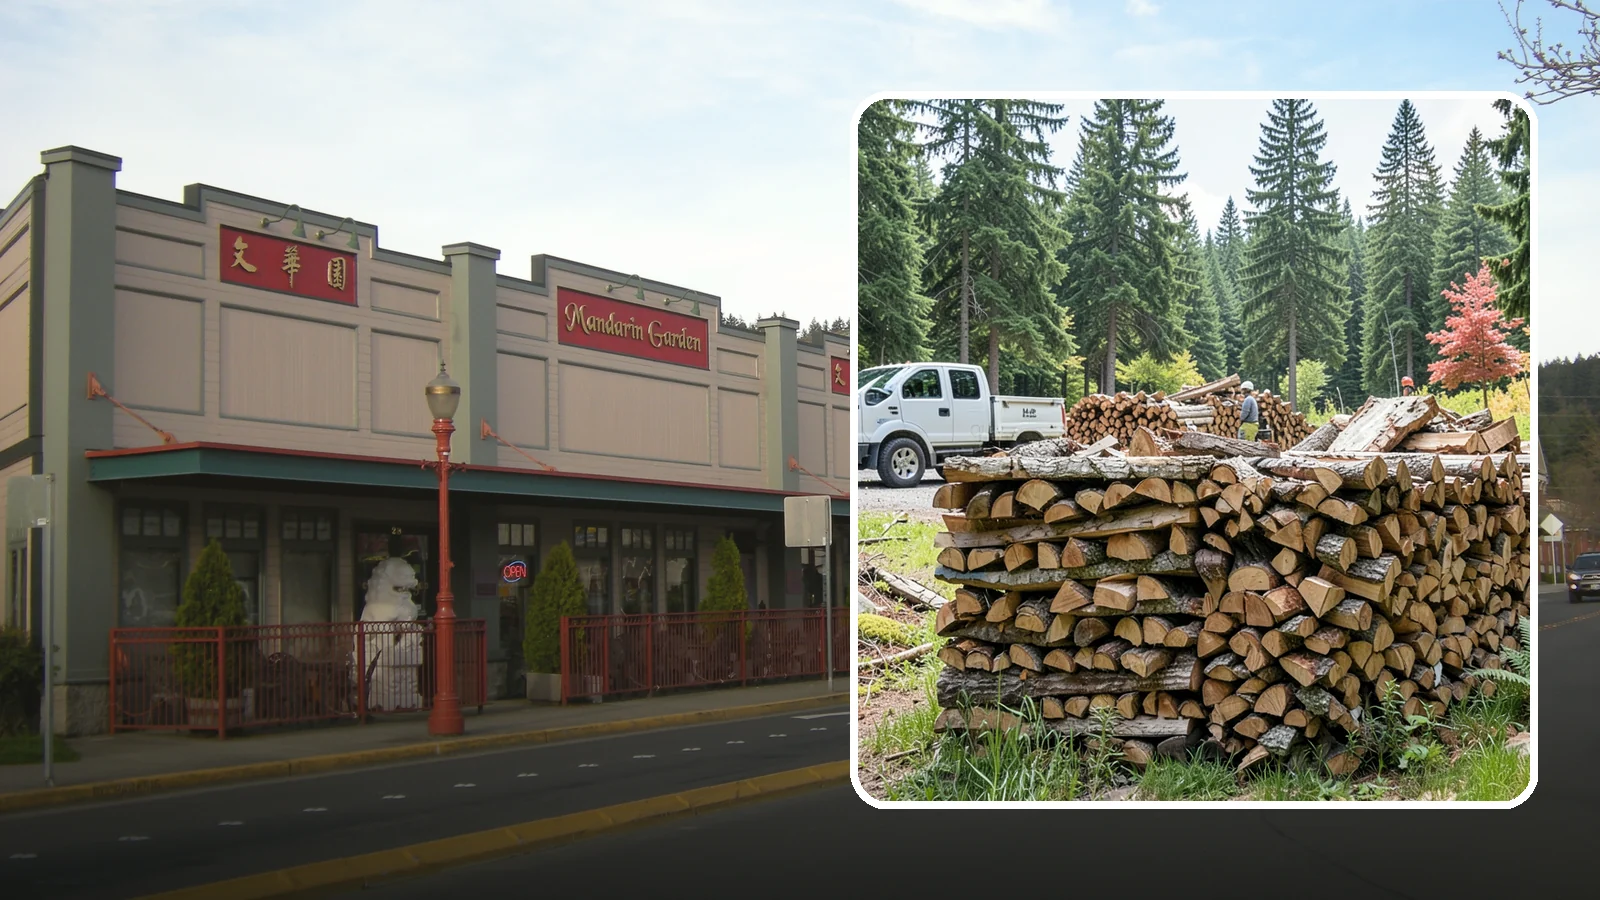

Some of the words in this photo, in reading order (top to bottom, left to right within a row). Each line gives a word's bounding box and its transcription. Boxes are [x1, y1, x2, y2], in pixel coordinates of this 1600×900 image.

[231, 236, 346, 290] 文華園
[564, 302, 644, 341] Mandarin
[648, 320, 701, 353] Garden
[503, 565, 527, 578] OPEN
